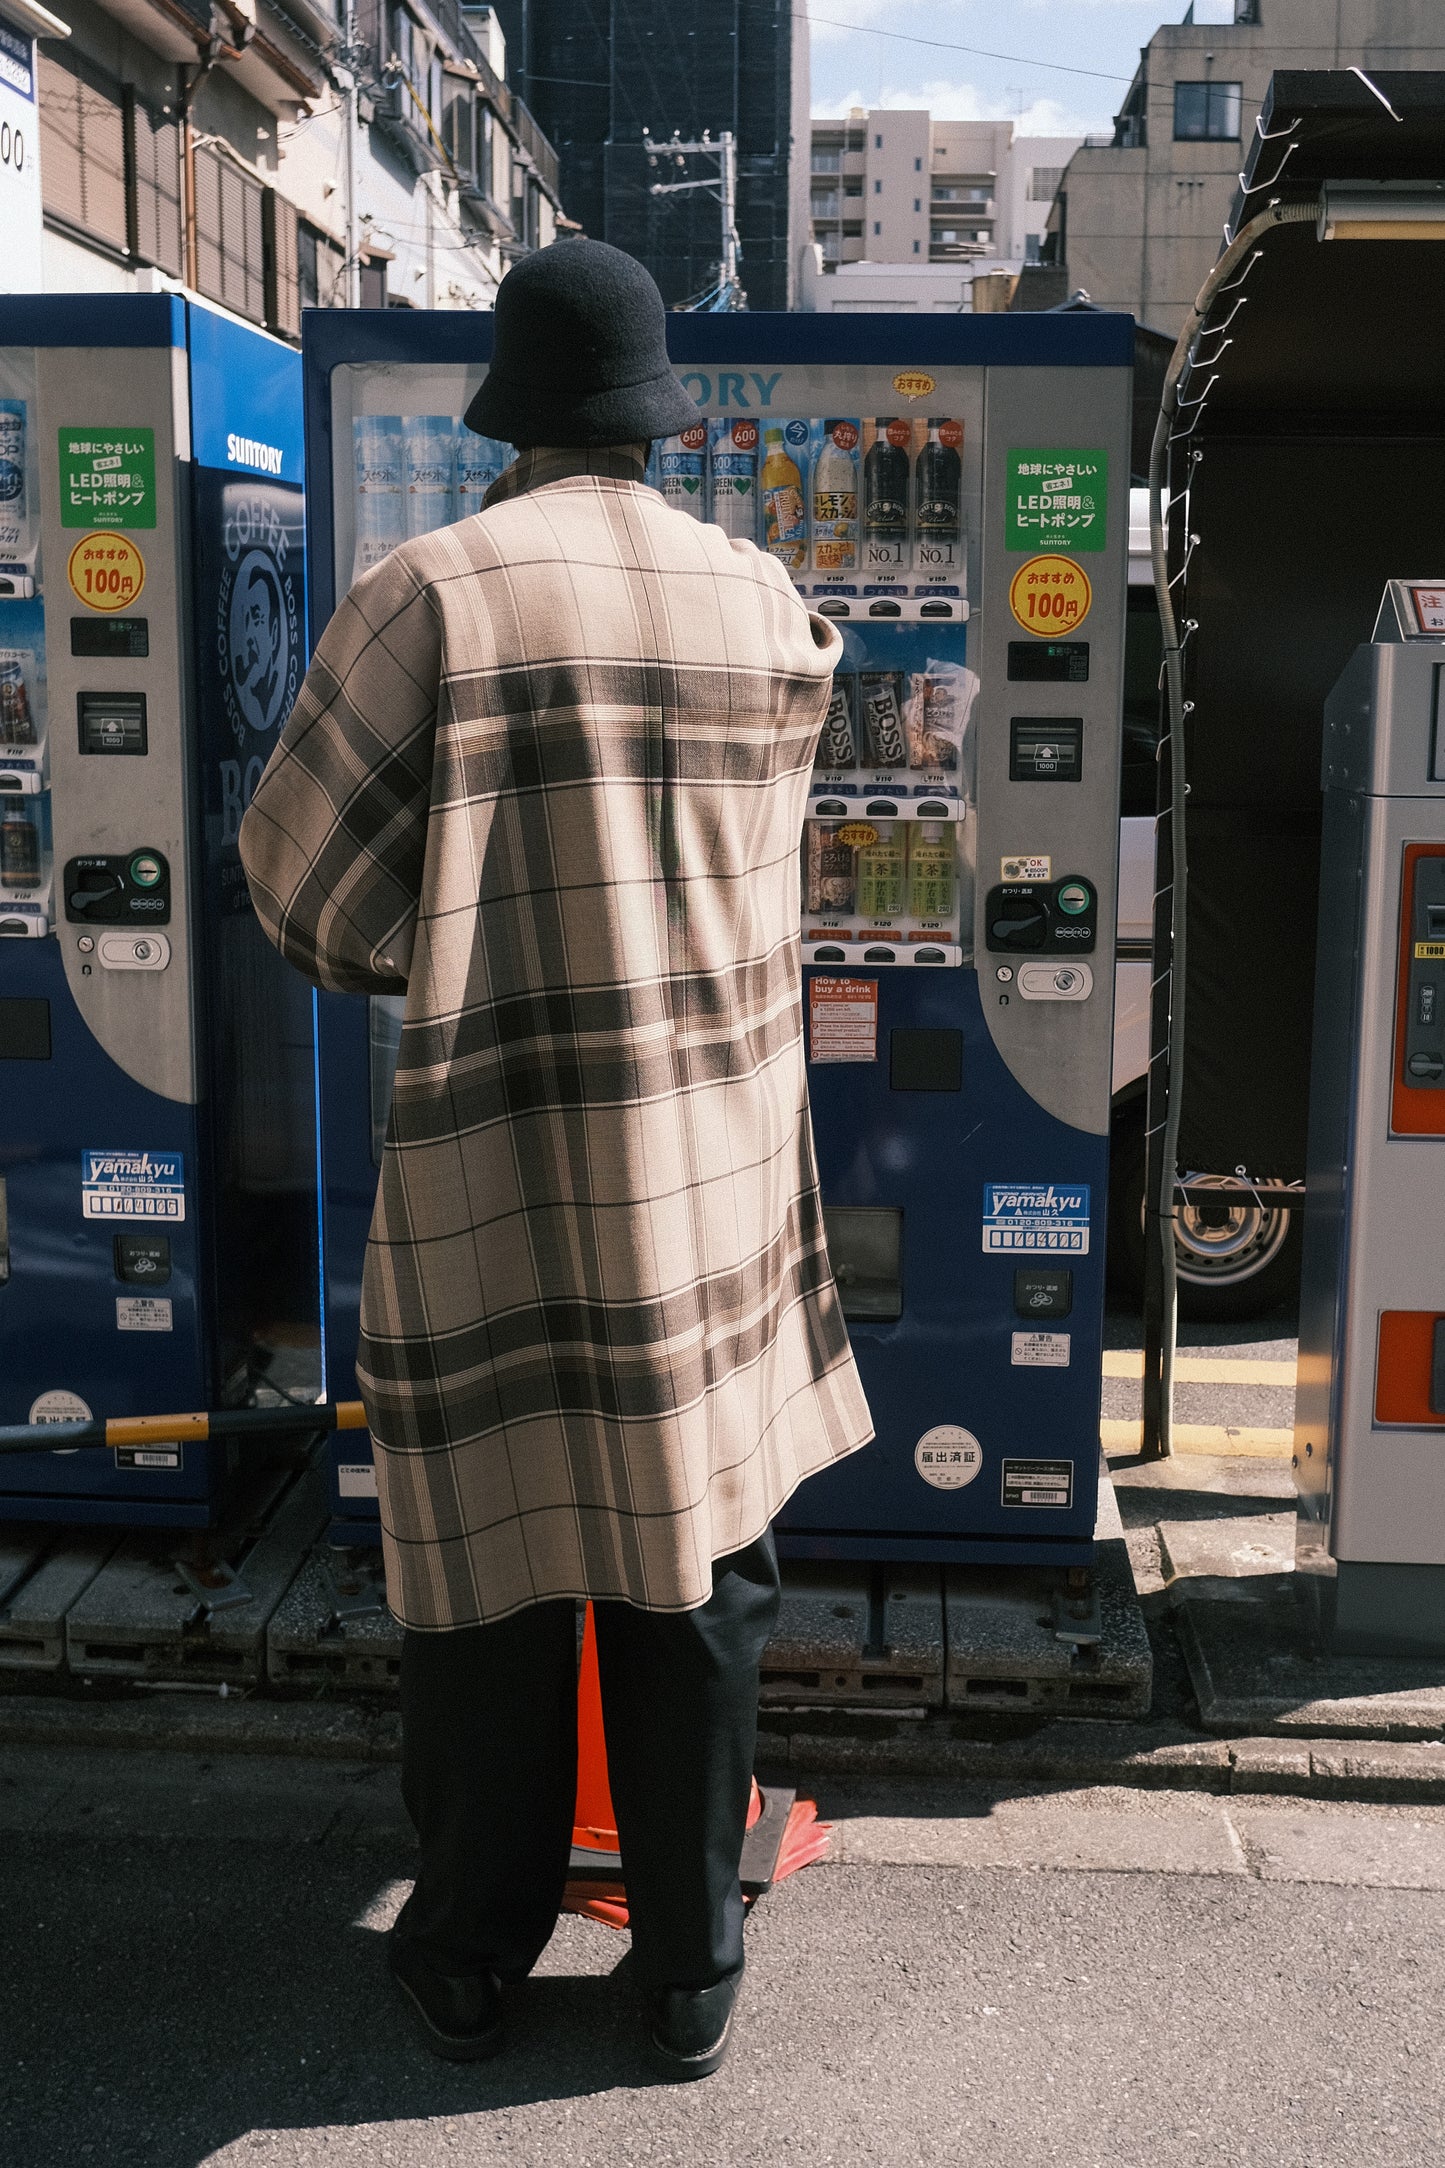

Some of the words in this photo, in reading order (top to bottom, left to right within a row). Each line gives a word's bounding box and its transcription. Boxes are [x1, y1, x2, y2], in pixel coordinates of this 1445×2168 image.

[897, 379, 931, 391] おすすめ
[683, 429, 704, 443] 600
[734, 429, 756, 443] 600
[790, 422, 805, 438] 今
[68, 441, 145, 455] 地球にやさしい
[227, 433, 283, 474] SUNTORY
[414, 469, 447, 482] 天然水
[464, 469, 496, 482] 天然水
[1017, 463, 1098, 476] 地球にやさしい
[70, 473, 145, 488] LED照明&
[70, 490, 146, 506] ヒートポンプ
[820, 495, 849, 506] レモン
[1017, 495, 1096, 510] LED照明&
[1016, 512, 1096, 528] ヒートポンプ
[83, 549, 129, 561] おすすめ
[868, 542, 905, 563] NO.1
[920, 543, 956, 564] NO.1
[84, 569, 133, 594] 100円
[1027, 572, 1075, 584] おすすめ
[867, 587, 905, 596] つめたい
[1027, 593, 1078, 618] 100円
[828, 695, 853, 761] BOSS
[873, 694, 903, 759] BOSS
[841, 829, 875, 841] おすすめ
[875, 862, 889, 876] 茶
[926, 863, 939, 877] 茶
[1030, 859, 1042, 867] OK
[1426, 946, 1444, 955] 1000
[815, 977, 837, 985] How
[815, 985, 833, 993] buy
[845, 985, 871, 993] drink
[90, 1153, 175, 1182] yamakyu
[992, 1186, 1082, 1216] yamakyu
[922, 1451, 976, 1463] 届出済証
